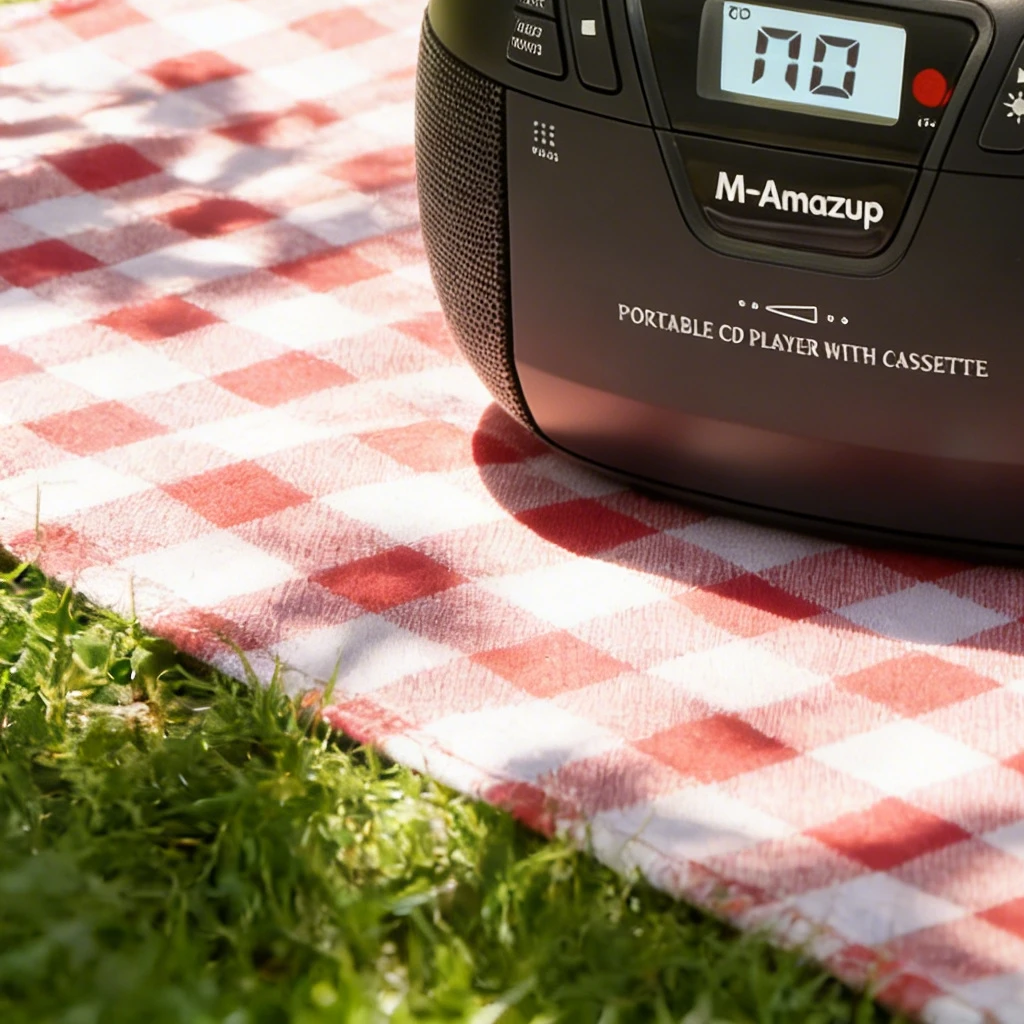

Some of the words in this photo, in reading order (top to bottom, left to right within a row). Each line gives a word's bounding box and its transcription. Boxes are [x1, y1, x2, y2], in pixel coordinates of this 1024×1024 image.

[715, 171, 884, 230] M-Amazup
[618, 303, 714, 340] PORTABLE
[718, 323, 745, 344] CD
[749, 328, 820, 358] PLAYER
[823, 341, 876, 366] WITH
[882, 349, 989, 378] CASSETTE
